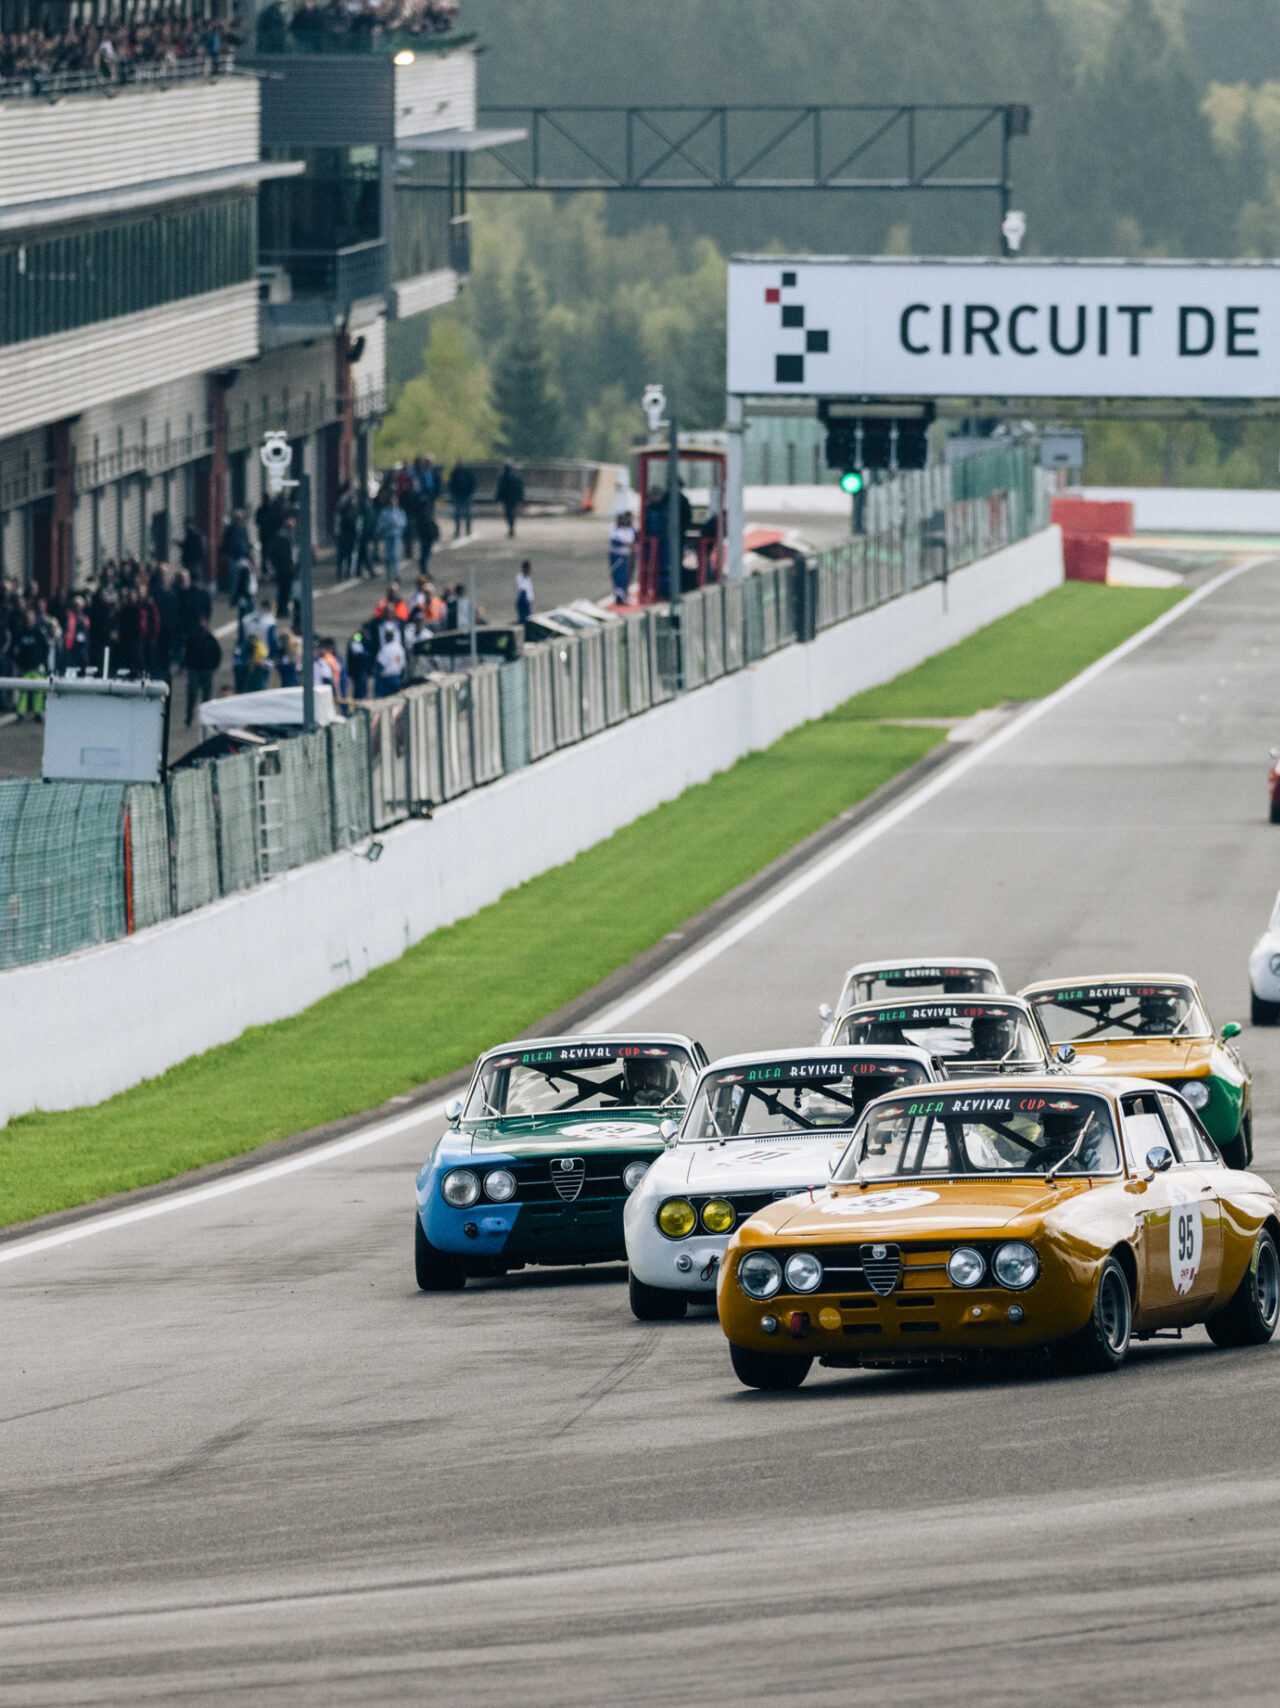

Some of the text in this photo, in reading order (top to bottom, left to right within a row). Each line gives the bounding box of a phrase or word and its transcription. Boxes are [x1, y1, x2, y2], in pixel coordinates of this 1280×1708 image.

[900, 304, 1152, 356] CIRCUIT
[1178, 307, 1259, 357] DE
[912, 1007, 959, 1018] REVIVAL
[522, 1047, 641, 1063] ALFA REVIVAL CUP
[749, 1063, 877, 1080] ALFA REVIVAL CUP
[907, 1098, 1047, 1115] ALFA REVIVAL CUP
[1178, 1214, 1194, 1261] 95
